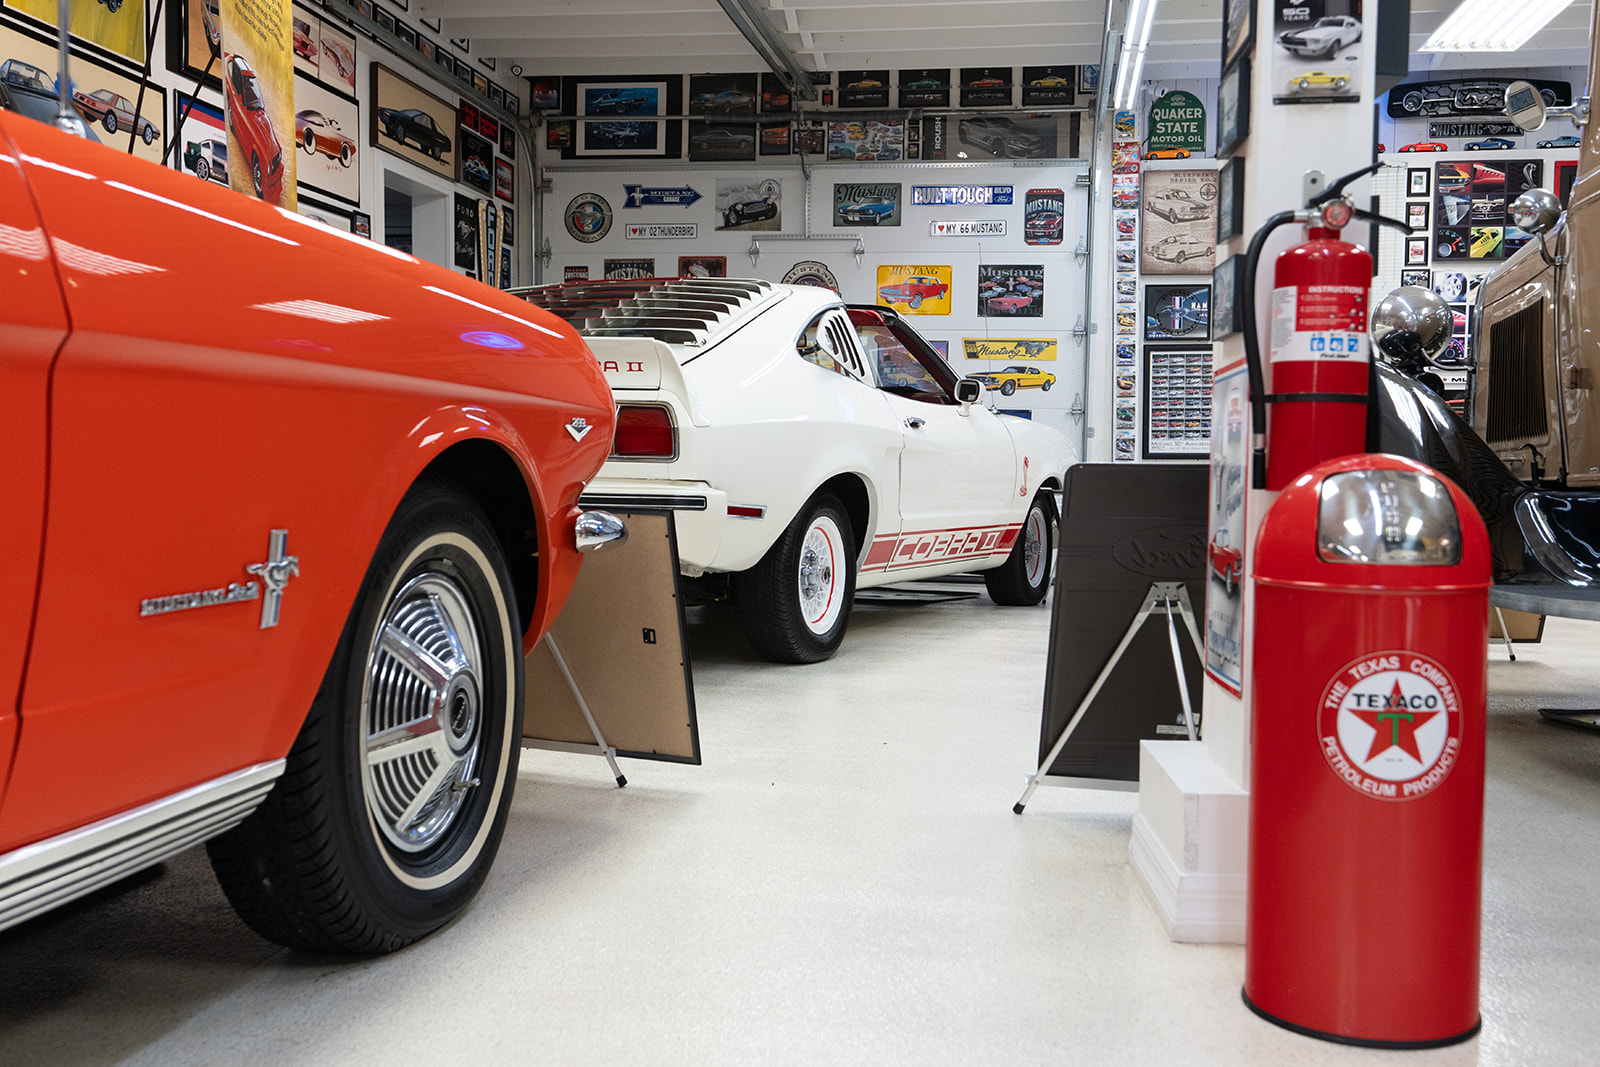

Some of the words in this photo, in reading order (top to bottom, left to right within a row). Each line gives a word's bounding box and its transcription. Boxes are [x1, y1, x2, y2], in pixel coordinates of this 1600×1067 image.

[1152, 107, 1203, 121] QUAKER
[1156, 121, 1198, 133] STATE
[1436, 123, 1483, 136] MUSTANG
[1151, 135, 1185, 143] MOTOR
[574, 195, 604, 204] FORD
[835, 184, 897, 203] Mustang
[914, 187, 948, 204] BUILT
[951, 187, 993, 204] TOUGH
[1026, 198, 1063, 215] MUSTANG
[569, 226, 607, 240] MUSTANG
[638, 226, 647, 236] MY
[657, 226, 695, 236] THUNDERBIRD
[946, 224, 957, 233] MY
[971, 223, 1003, 233] MUSTANG
[889, 266, 938, 275] MUSTANG
[980, 267, 1043, 279] Mustang
[1308, 285, 1364, 294] INSTRUCTIONS
[976, 344, 1026, 359] Mustang
[626, 362, 644, 372] II
[892, 532, 981, 563] COBRA
[1325, 681, 1349, 709] THE
[1348, 656, 1400, 680] TEXAS
[1410, 659, 1459, 713] COMPANY
[1353, 693, 1437, 709] TEXACO
[1377, 713, 1413, 746] T
[1323, 735, 1397, 797] PETROLEUM
[1402, 736, 1459, 797] PRODUCTS
